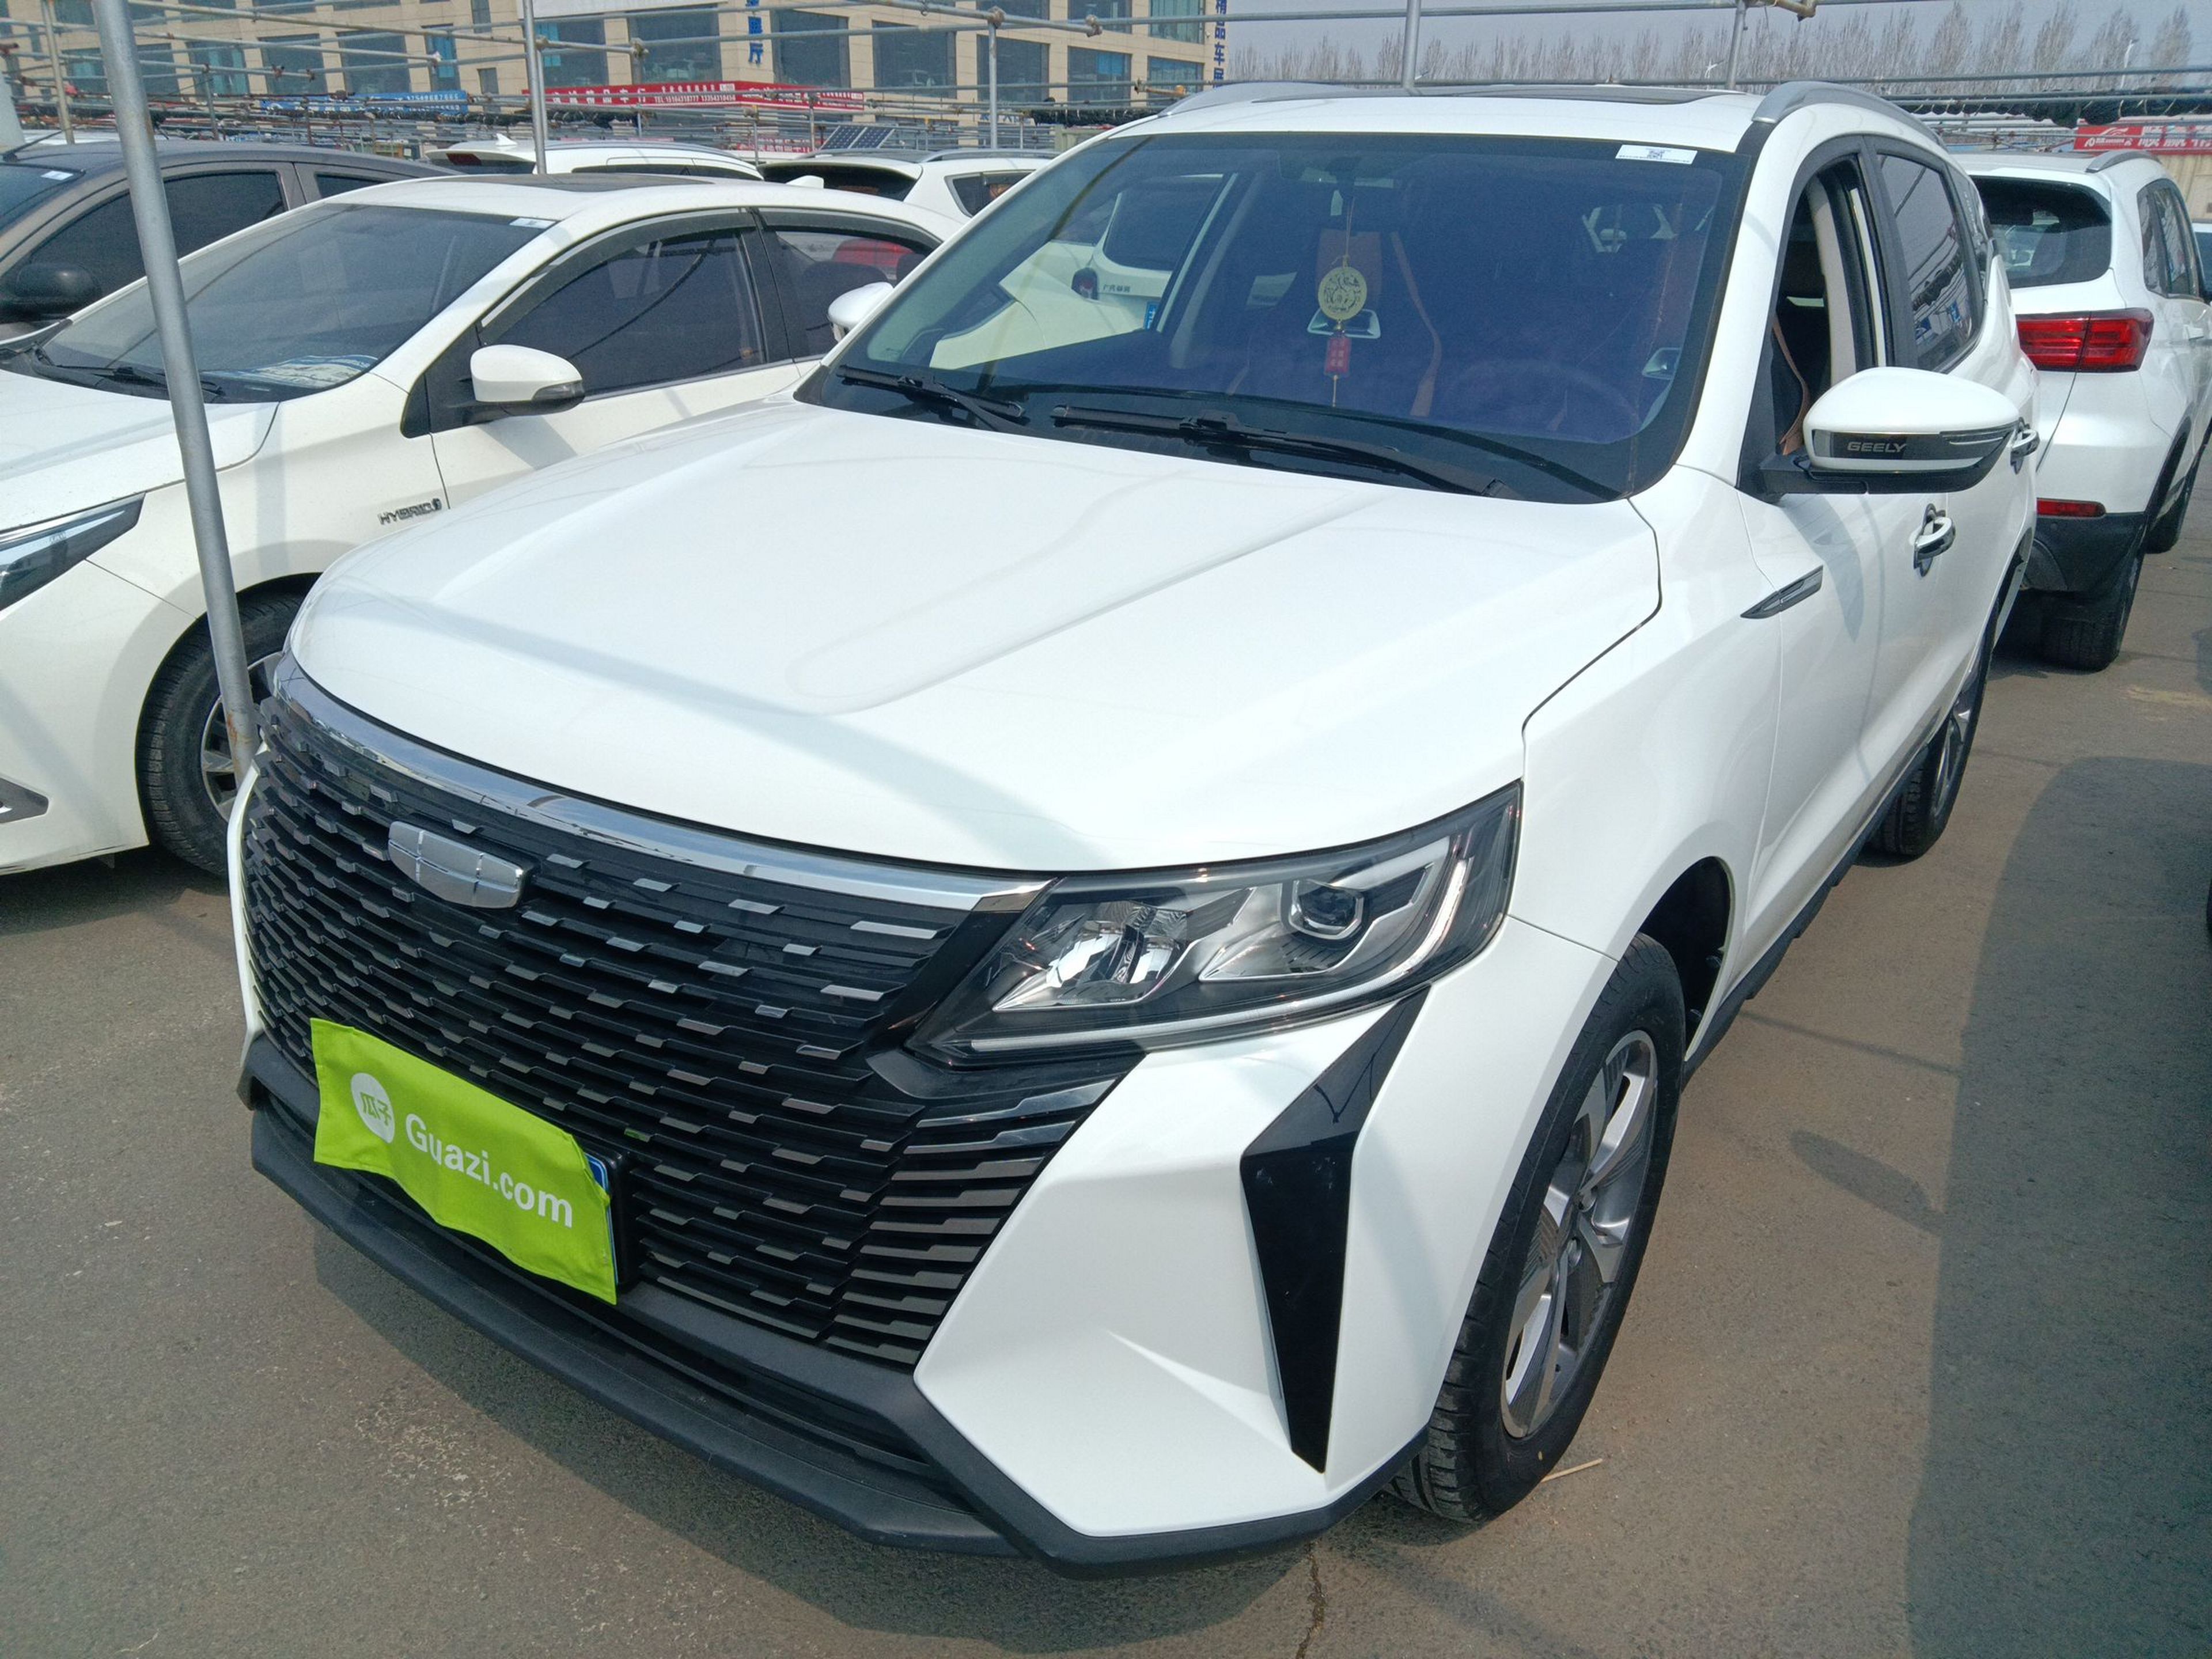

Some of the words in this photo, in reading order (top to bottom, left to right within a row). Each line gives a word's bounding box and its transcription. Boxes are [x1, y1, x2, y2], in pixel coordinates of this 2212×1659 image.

[1847, 441, 1907, 453] GEELY
[378, 502, 433, 525] HYBRID
[360, 1092, 392, 1127] 瓜子
[406, 1113, 573, 1228] Guazi.com
